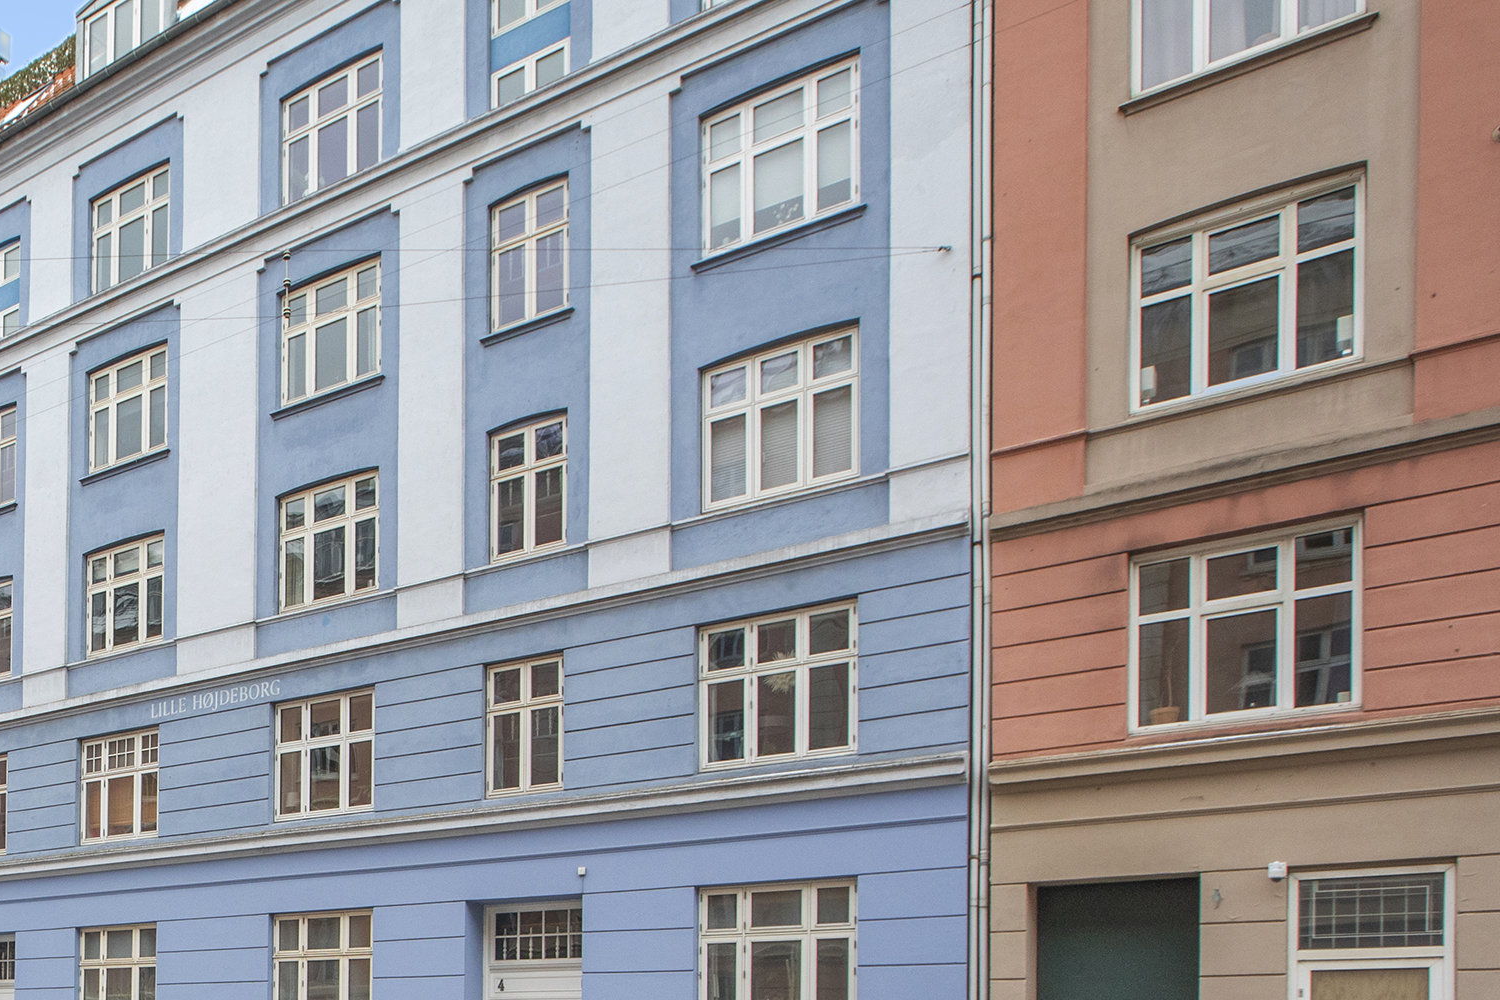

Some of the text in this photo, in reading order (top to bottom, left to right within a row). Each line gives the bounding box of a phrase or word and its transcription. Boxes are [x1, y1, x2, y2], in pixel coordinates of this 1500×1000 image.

[150, 679, 280, 719] LILLE HØJDEBORG
[497, 978, 505, 992] 4
